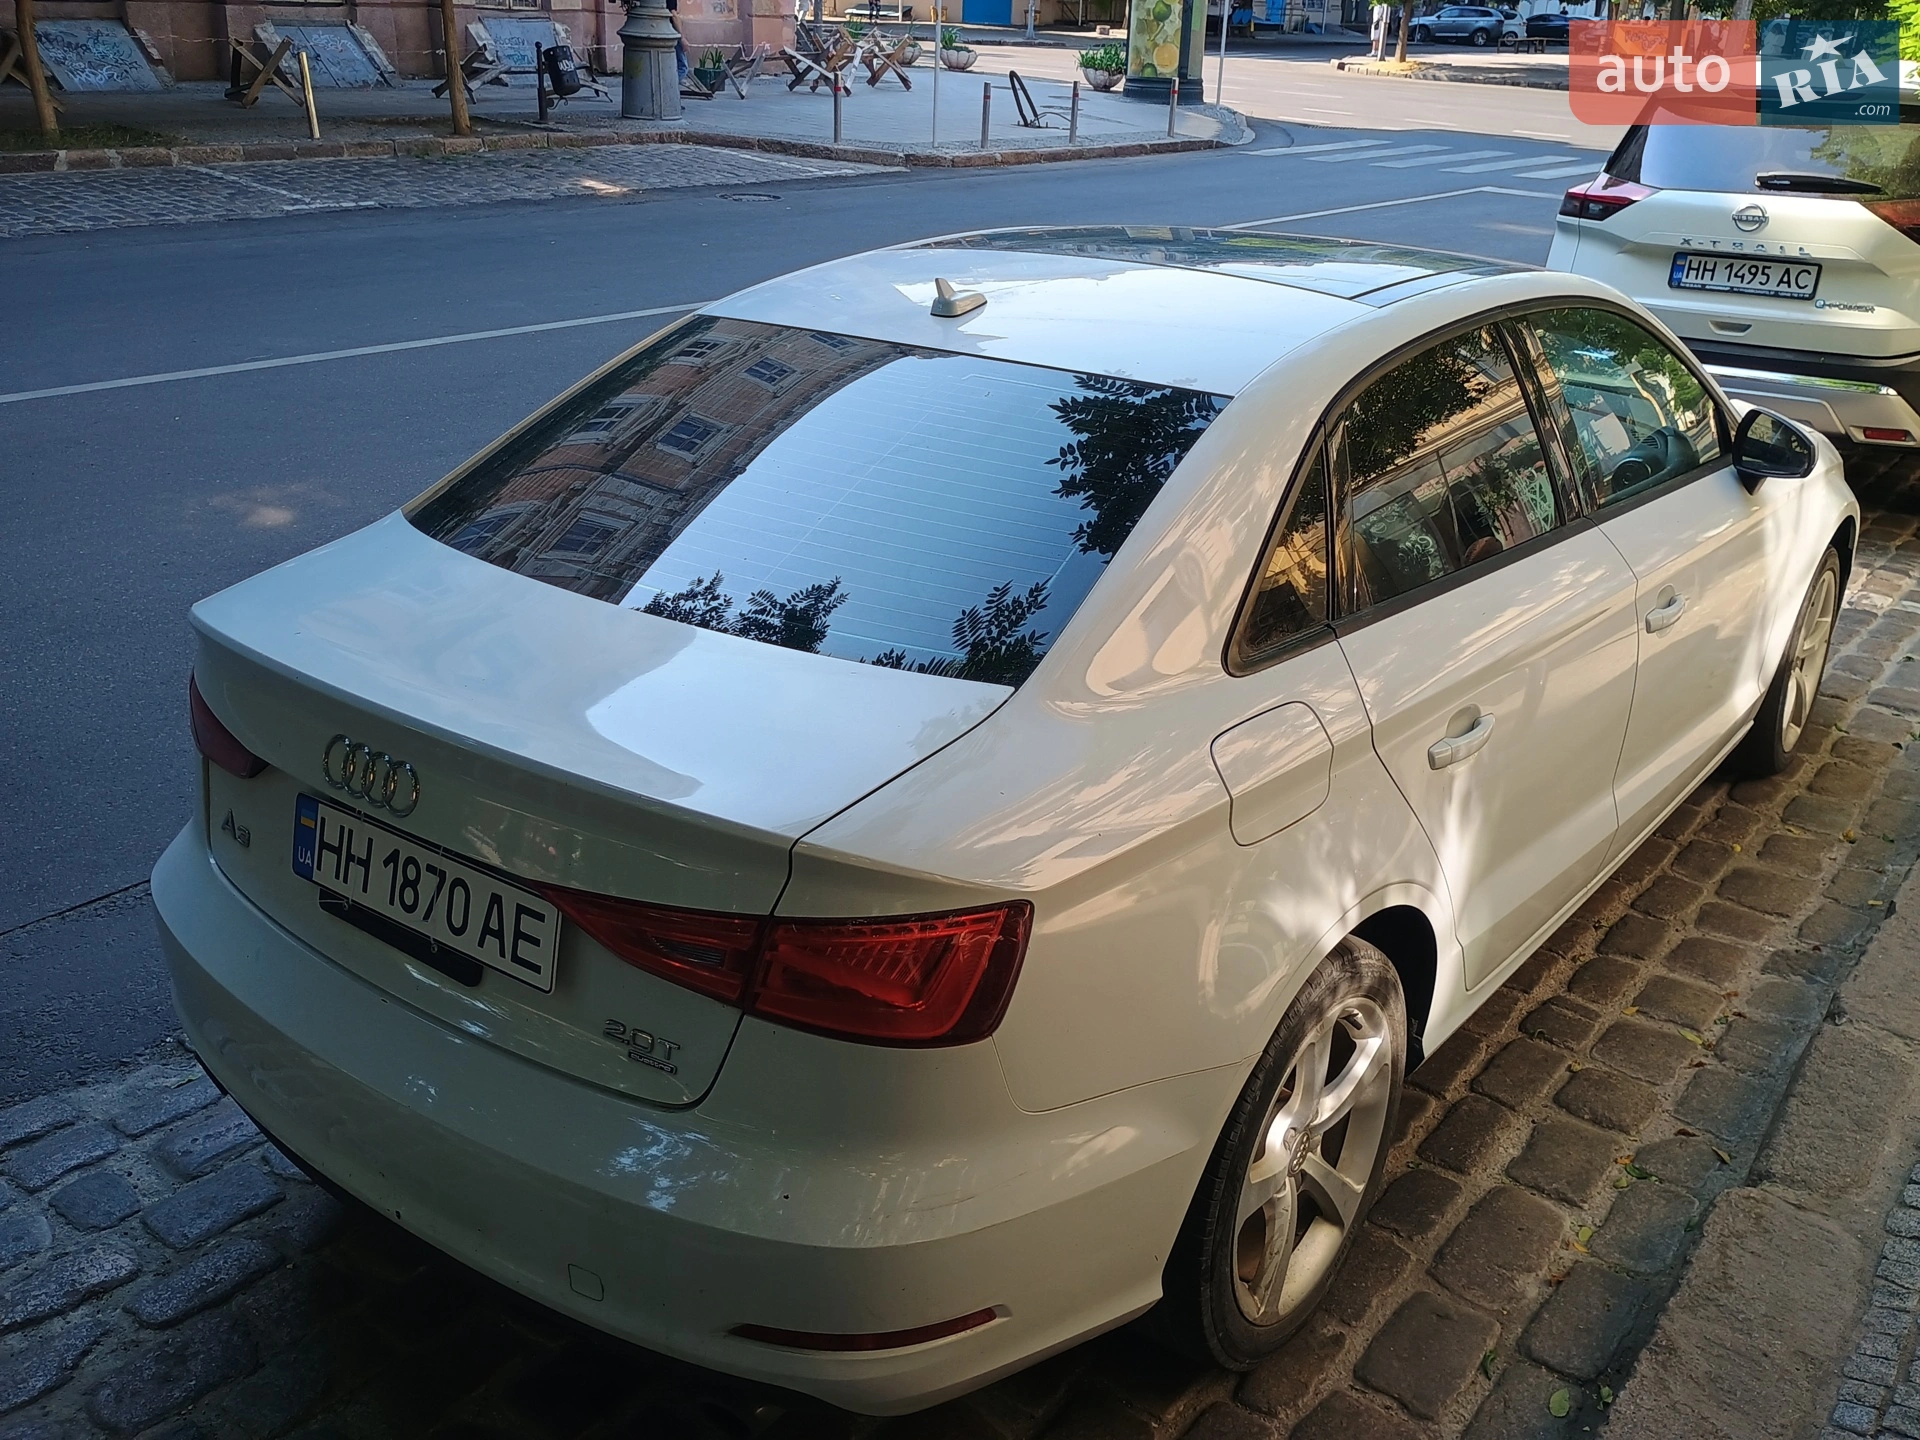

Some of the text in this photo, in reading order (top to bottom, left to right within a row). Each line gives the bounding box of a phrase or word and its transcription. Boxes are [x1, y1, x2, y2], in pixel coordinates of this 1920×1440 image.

[1732, 214, 1767, 223] NISSAN
[1673, 271, 1683, 279] UA
[1685, 259, 1812, 290] HH 1495 AC
[221, 808, 251, 848] A3
[297, 845, 312, 867] UA
[316, 816, 547, 976] HH 1870 AE
[603, 1018, 681, 1061] 2.0T
[630, 1053, 672, 1072] quattro
